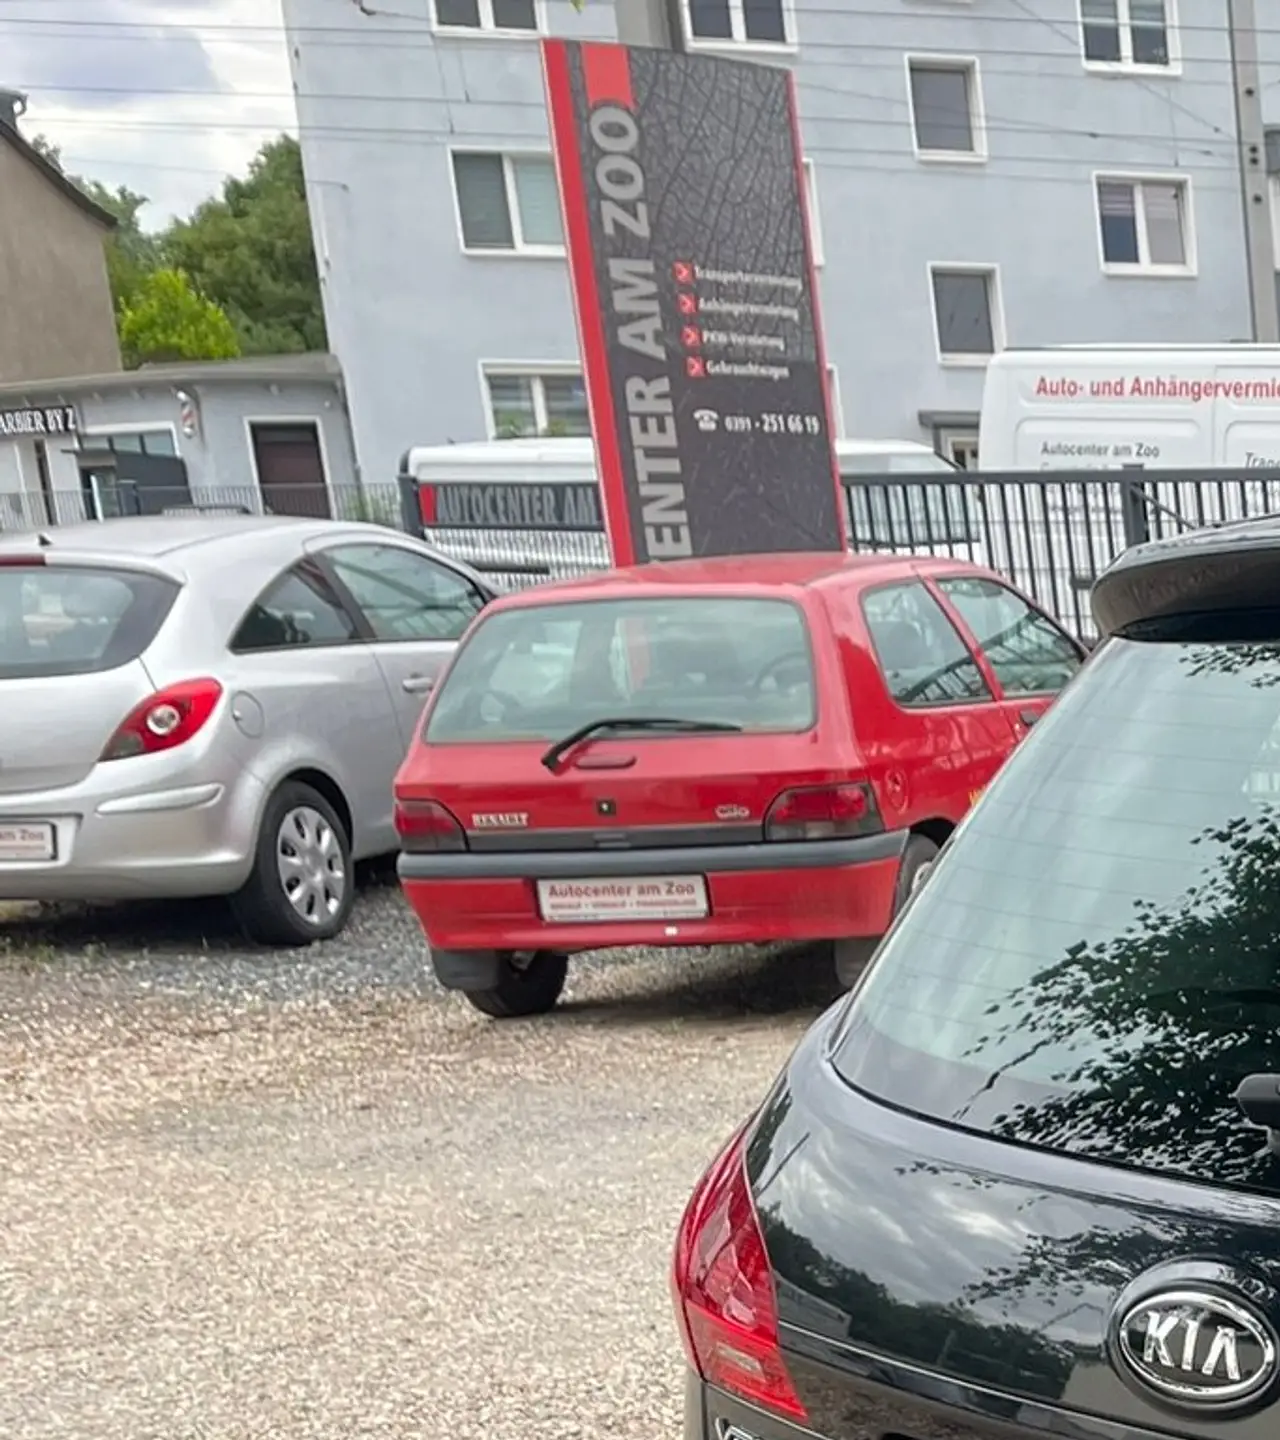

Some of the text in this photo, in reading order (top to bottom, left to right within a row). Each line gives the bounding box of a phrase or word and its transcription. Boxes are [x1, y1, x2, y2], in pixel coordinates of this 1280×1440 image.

[590, 106, 692, 562] ENTER AM ZOO
[1036, 376, 1084, 397] Auto-
[1090, 377, 1124, 397] und
[762, 413, 785, 433] 251
[1041, 441, 1160, 457] Autocenter am Zoo
[437, 485, 557, 525] AUTOCENTER
[549, 880, 696, 898] Autocenter am Zoo
[1144, 1310, 1241, 1381] KIA
